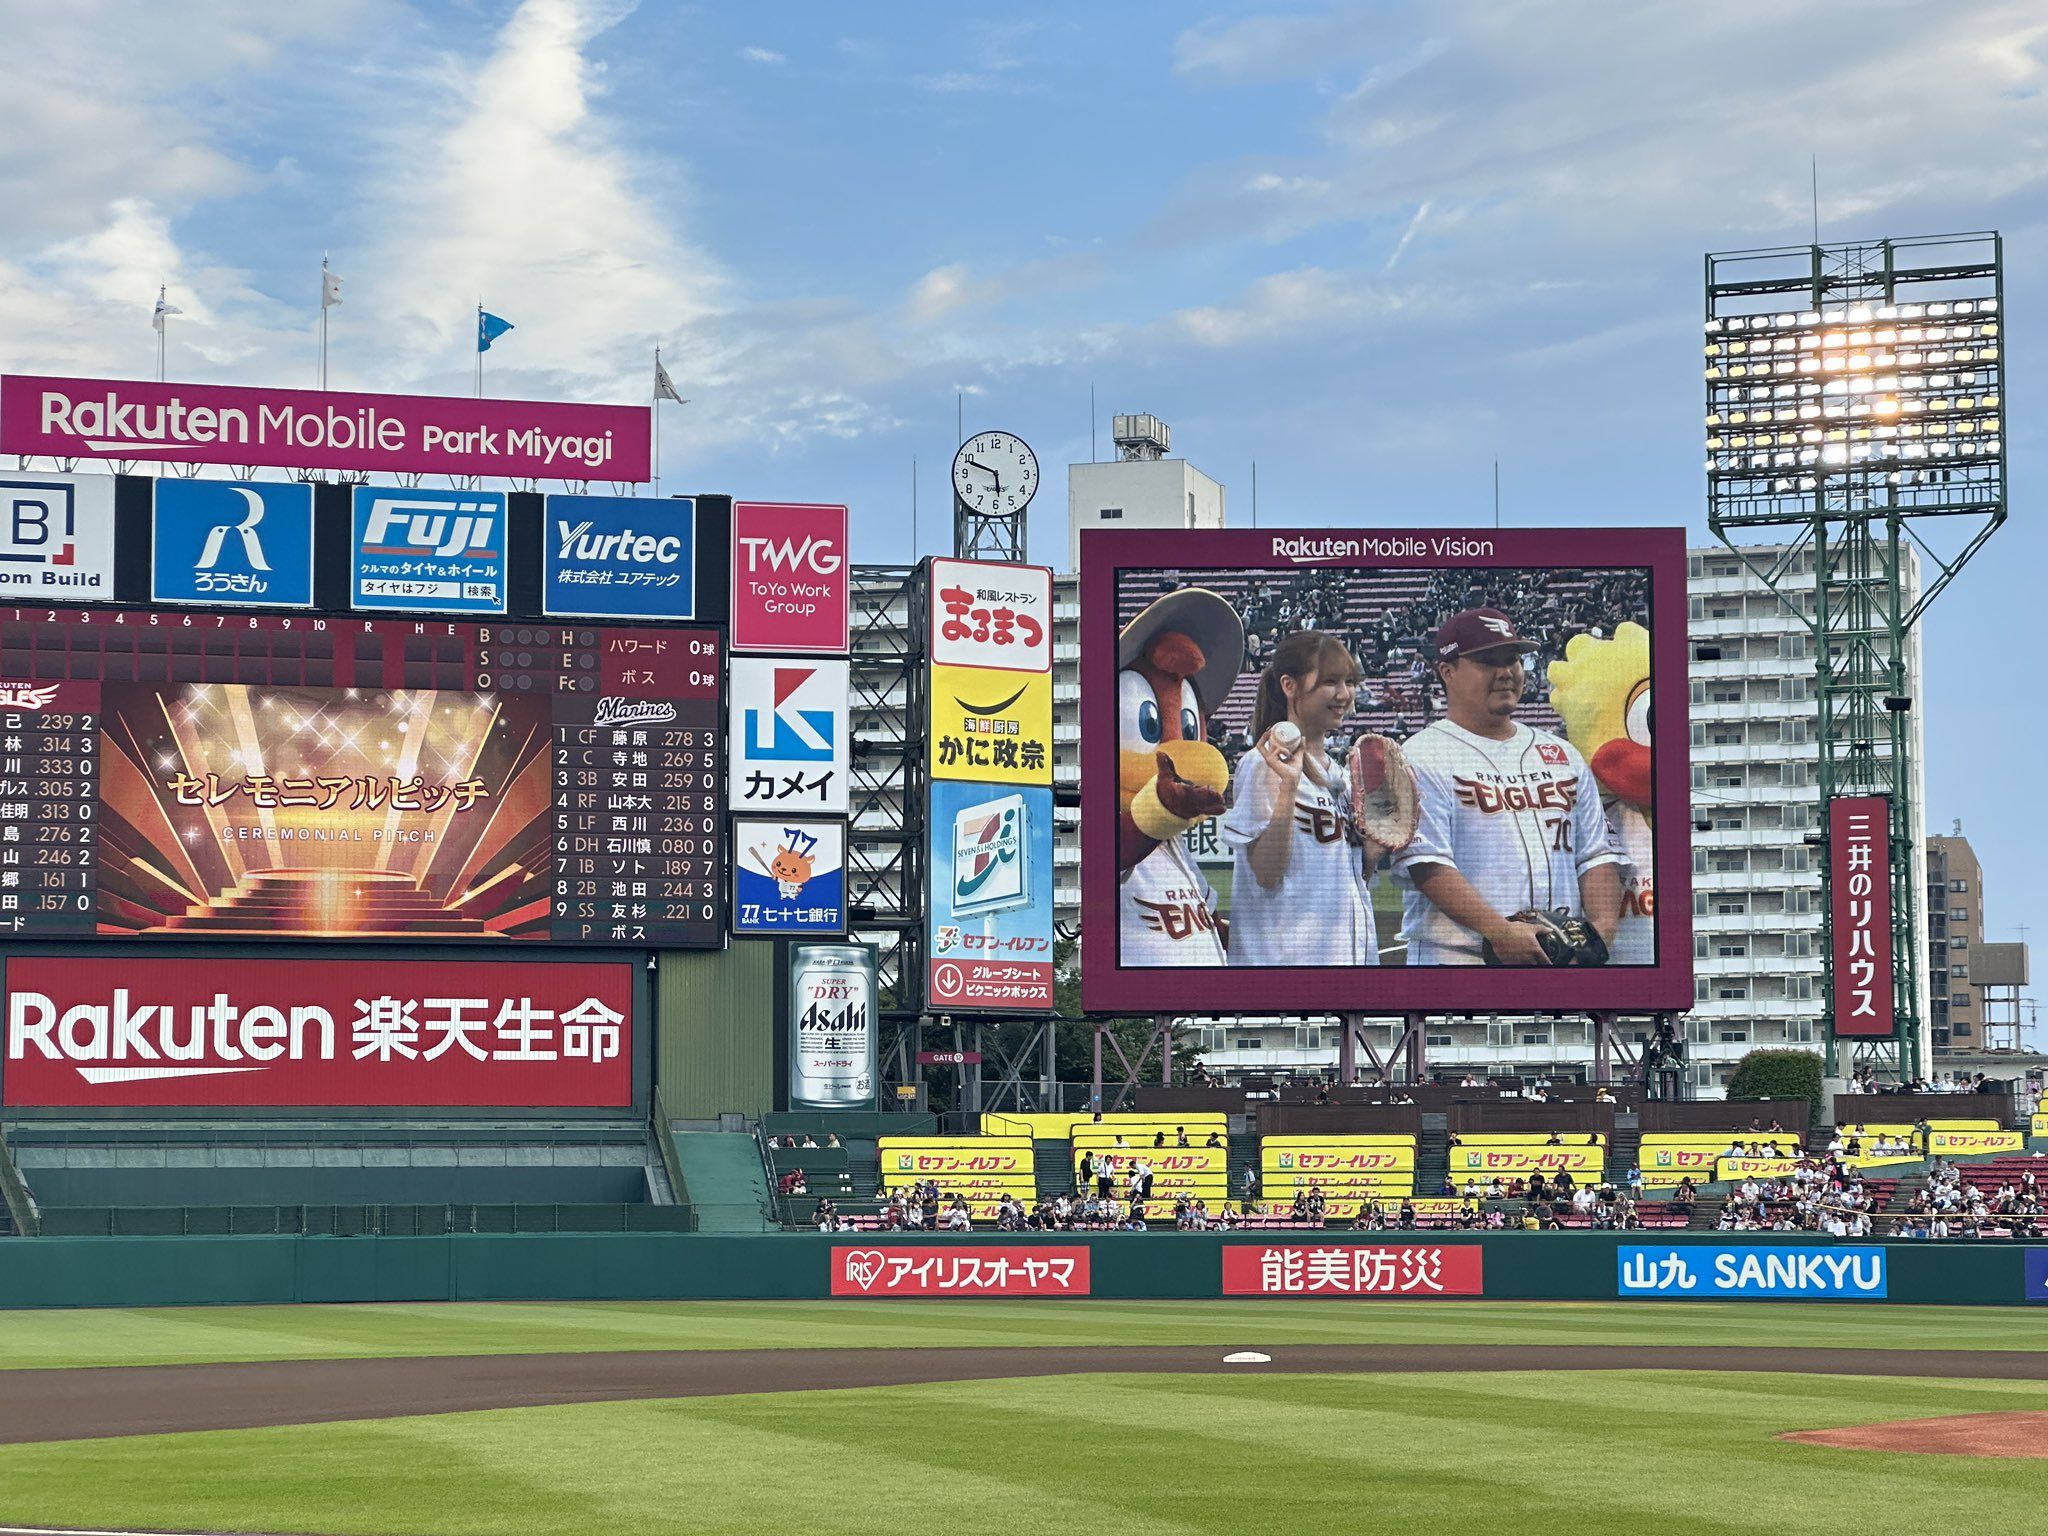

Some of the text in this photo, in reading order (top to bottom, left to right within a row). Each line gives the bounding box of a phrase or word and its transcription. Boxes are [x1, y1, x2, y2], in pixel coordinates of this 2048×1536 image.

[41, 391, 613, 467] Rakuten Mobile Park Miyagi
[12, 499, 49, 545] B
[363, 498, 498, 557] Fuji
[558, 520, 681, 564] Yurtec
[1272, 536, 1493, 557] Rakuten Mobile Vision
[739, 534, 841, 575] TWG
[42, 571, 101, 587] Build
[194, 572, 268, 593] ろうきん
[558, 569, 681, 587] 株式会社 ユアテック
[364, 581, 439, 595] タイヤはフジ
[467, 584, 493, 598] 検索
[749, 582, 832, 598] ToYo Work
[976, 588, 1037, 604] 和風レストラン
[764, 599, 816, 617] Group
[939, 584, 1043, 648] まるまつ
[364, 621, 455, 635] R H E
[479, 628, 490, 643] B
[562, 630, 573, 645] H
[609, 640, 667, 655] ハワード
[480, 651, 489, 665] S
[562, 653, 572, 668] E
[478, 673, 491, 688] O
[559, 675, 576, 690] Fc
[621, 669, 655, 685] ボス
[595, 697, 676, 726] Marines
[6, 713, 92, 730] 己 .239 2
[964, 718, 1019, 735] 海鮮厨房
[4, 735, 92, 753] 林 .314 3
[560, 728, 566, 742] 1
[578, 729, 597, 744] CF
[661, 732, 693, 746] .278
[703, 732, 714, 747] 3
[558, 750, 568, 764] 2
[582, 750, 593, 765] C
[660, 752, 693, 767] .269
[703, 753, 713, 768] 5
[938, 734, 1044, 770] かに政宗
[4, 758, 92, 775] 川 .333 0
[558, 771, 568, 786] 3
[577, 771, 598, 786] 3B
[660, 773, 693, 788] .259
[703, 774, 714, 789] 0
[744, 770, 835, 801] カメイ
[1476, 771, 1553, 784] RAKUTEN
[34, 782, 91, 797] .305 2
[167, 771, 490, 812] セレモニアルピッチ
[1460, 777, 1577, 814] EAGLES
[557, 793, 568, 808] 4
[578, 794, 597, 808] RF
[662, 796, 691, 810] .215
[703, 796, 714, 811] 8
[37, 804, 70, 819] .313
[79, 804, 91, 820] 0
[557, 815, 568, 830] 5
[578, 816, 596, 830] LF
[659, 817, 693, 832] .236
[702, 818, 714, 833] 0
[3, 825, 90, 843] 島 .276 2
[223, 826, 436, 843] CEREMONIAL PITCH
[1545, 817, 1573, 852] 70
[557, 837, 568, 851] 6
[575, 838, 599, 852] DH
[658, 839, 694, 854] .080
[702, 840, 714, 855] 0
[984, 836, 1017, 852] HOLDINGS
[3, 849, 90, 865] 山 .246 2
[557, 859, 567, 873] 7
[578, 859, 595, 874] 1B
[661, 861, 691, 875] .189
[703, 861, 713, 875] 7
[38, 872, 65, 887] .161
[81, 872, 86, 887] 1
[557, 880, 568, 895] 8
[577, 881, 596, 895] 2B
[659, 882, 693, 897] .244
[703, 883, 713, 898] 3
[2, 895, 89, 911] 田 .157 0
[556, 902, 567, 917] 9
[578, 903, 595, 917] SS
[662, 904, 690, 919] .221
[702, 905, 714, 919] 0
[741, 904, 760, 919] 77
[762, 907, 838, 923] 七十七銀行
[1848, 815, 1876, 1017] 三井のリハウス
[582, 925, 646, 940] P ボス
[972, 966, 1041, 981] グループシート
[800, 1001, 866, 1032] Asahi
[9, 988, 625, 1063] Rakuten 楽天生命
[825, 1037, 841, 1050] 生
[887, 1257, 1075, 1288] アイリスオーヤマ
[1260, 1247, 1444, 1292] 能美防災
[1623, 1251, 1881, 1290] 山九 SANKYU
